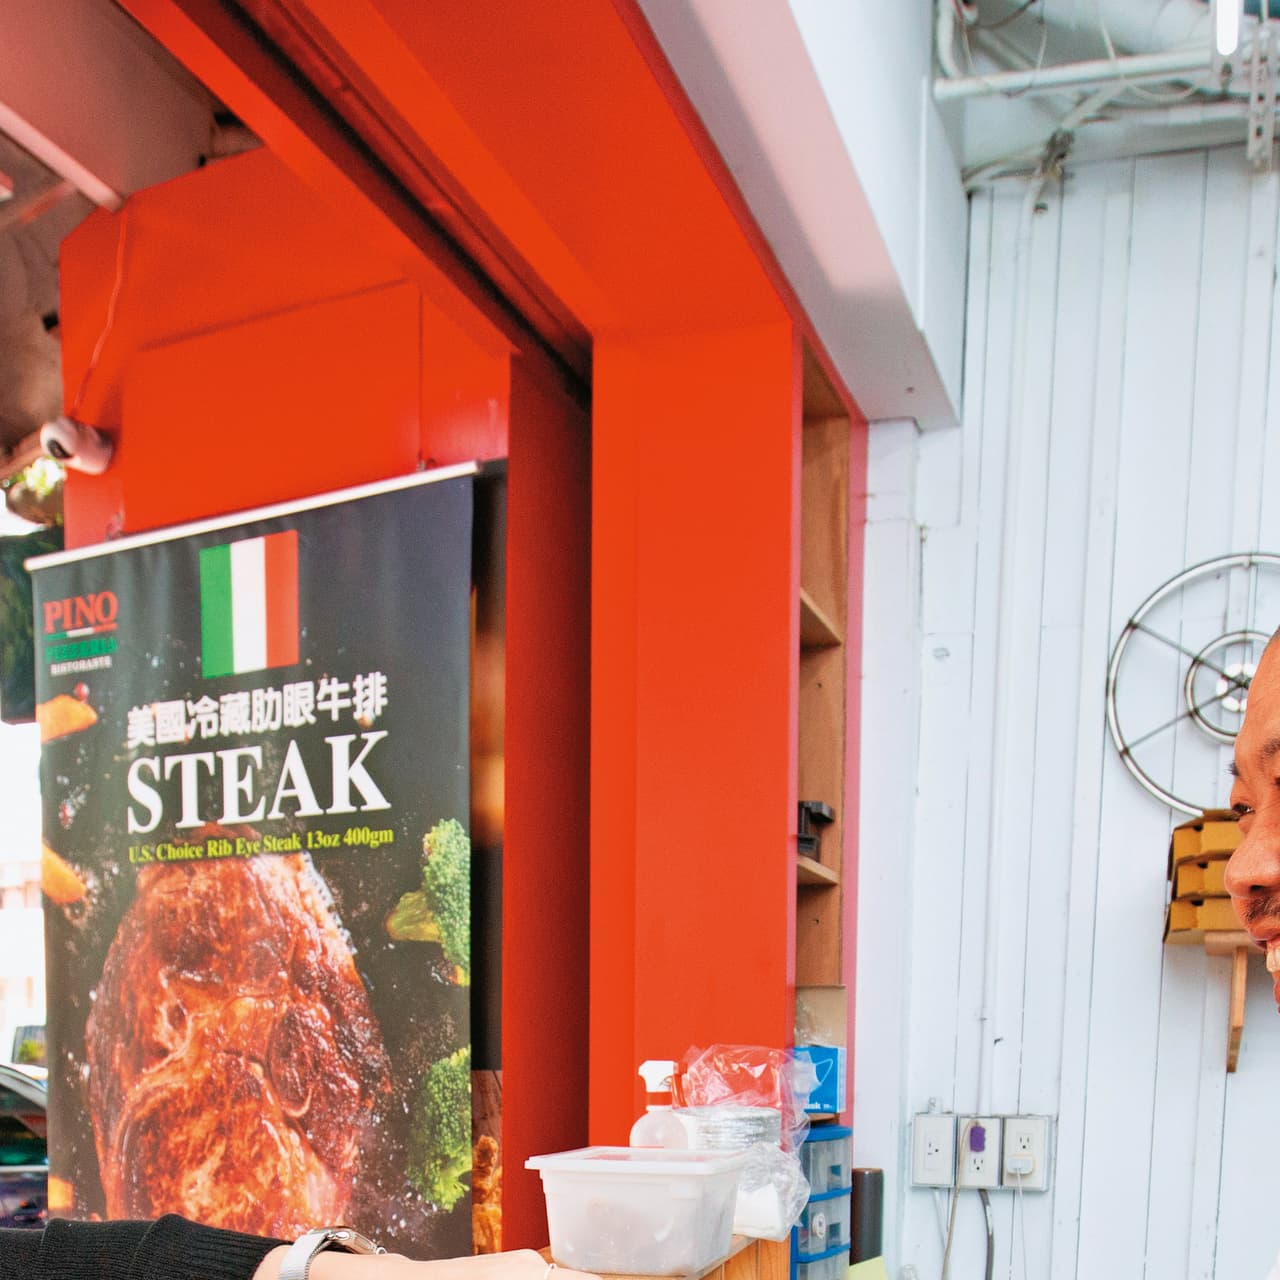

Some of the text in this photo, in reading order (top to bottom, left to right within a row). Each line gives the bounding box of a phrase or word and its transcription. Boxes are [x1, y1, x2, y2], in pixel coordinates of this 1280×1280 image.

[43, 591, 119, 633] PINO
[126, 672, 389, 750] 美國冷藏肋眼牛排
[126, 730, 392, 834] STEAK
[129, 826, 395, 865] U.S. Choice Rib Eye Steak 13oz 400gm
